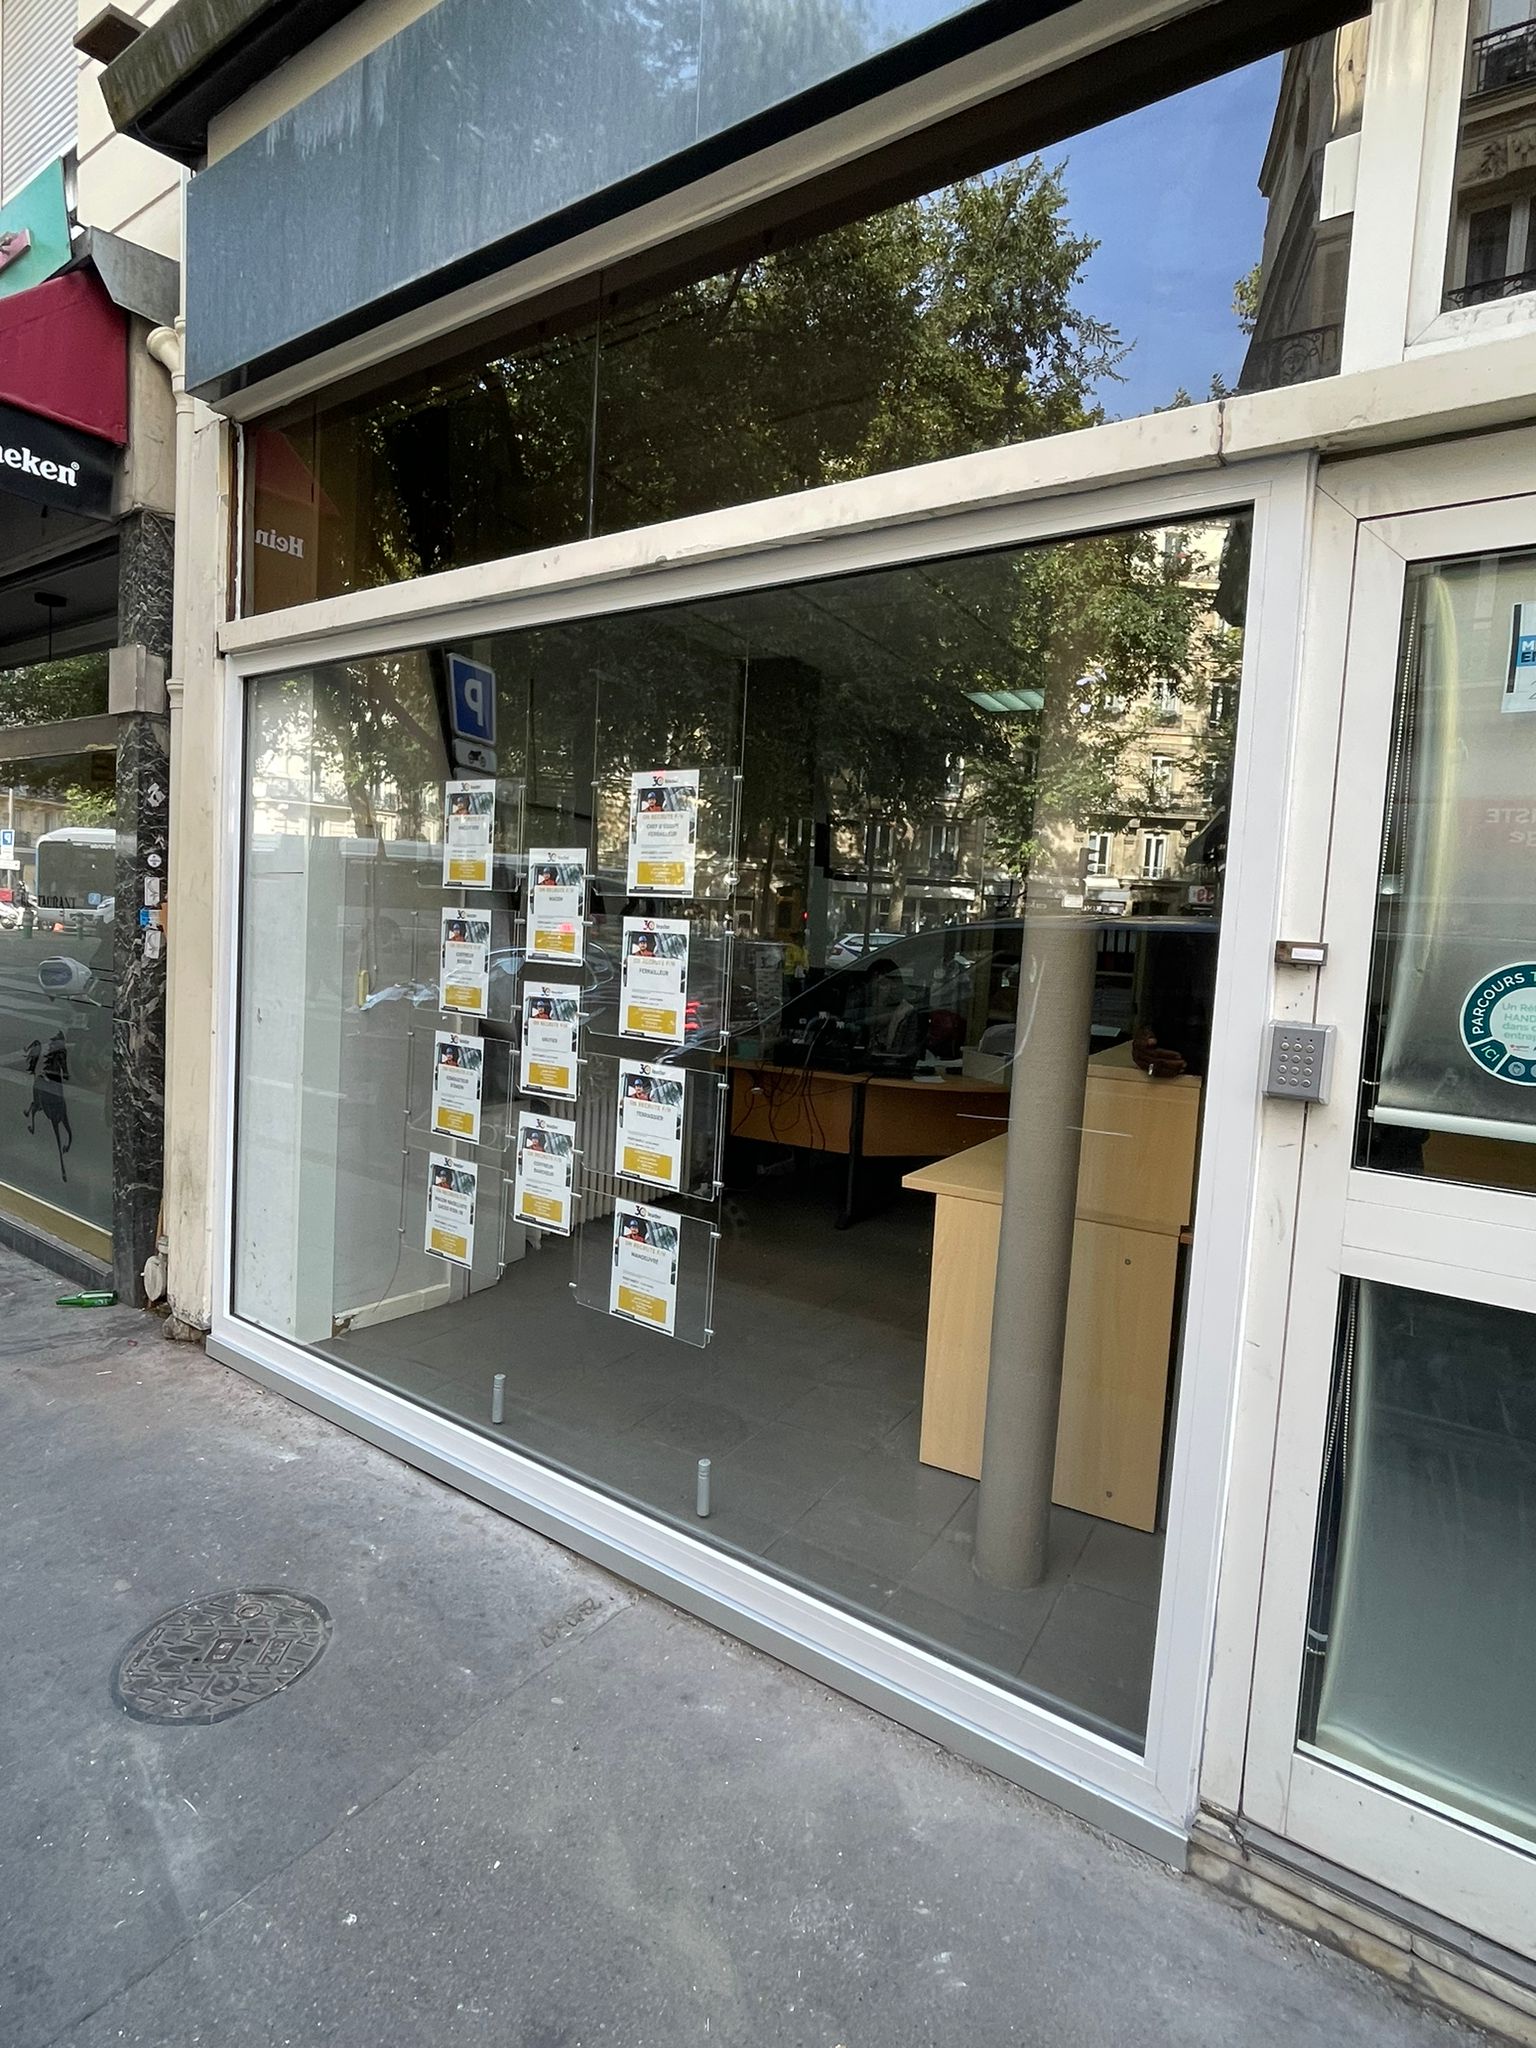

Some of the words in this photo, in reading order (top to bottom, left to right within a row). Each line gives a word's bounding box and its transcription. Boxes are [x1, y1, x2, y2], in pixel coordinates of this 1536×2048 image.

[0, 444, 80, 487] eken
[1522, 640, 1536, 652] M
[1471, 972, 1525, 1035] PARCOURS
[1502, 1003, 1517, 1011] Un
[1502, 1022, 1529, 1031] dans
[1480, 1045, 1500, 1062] ICI
